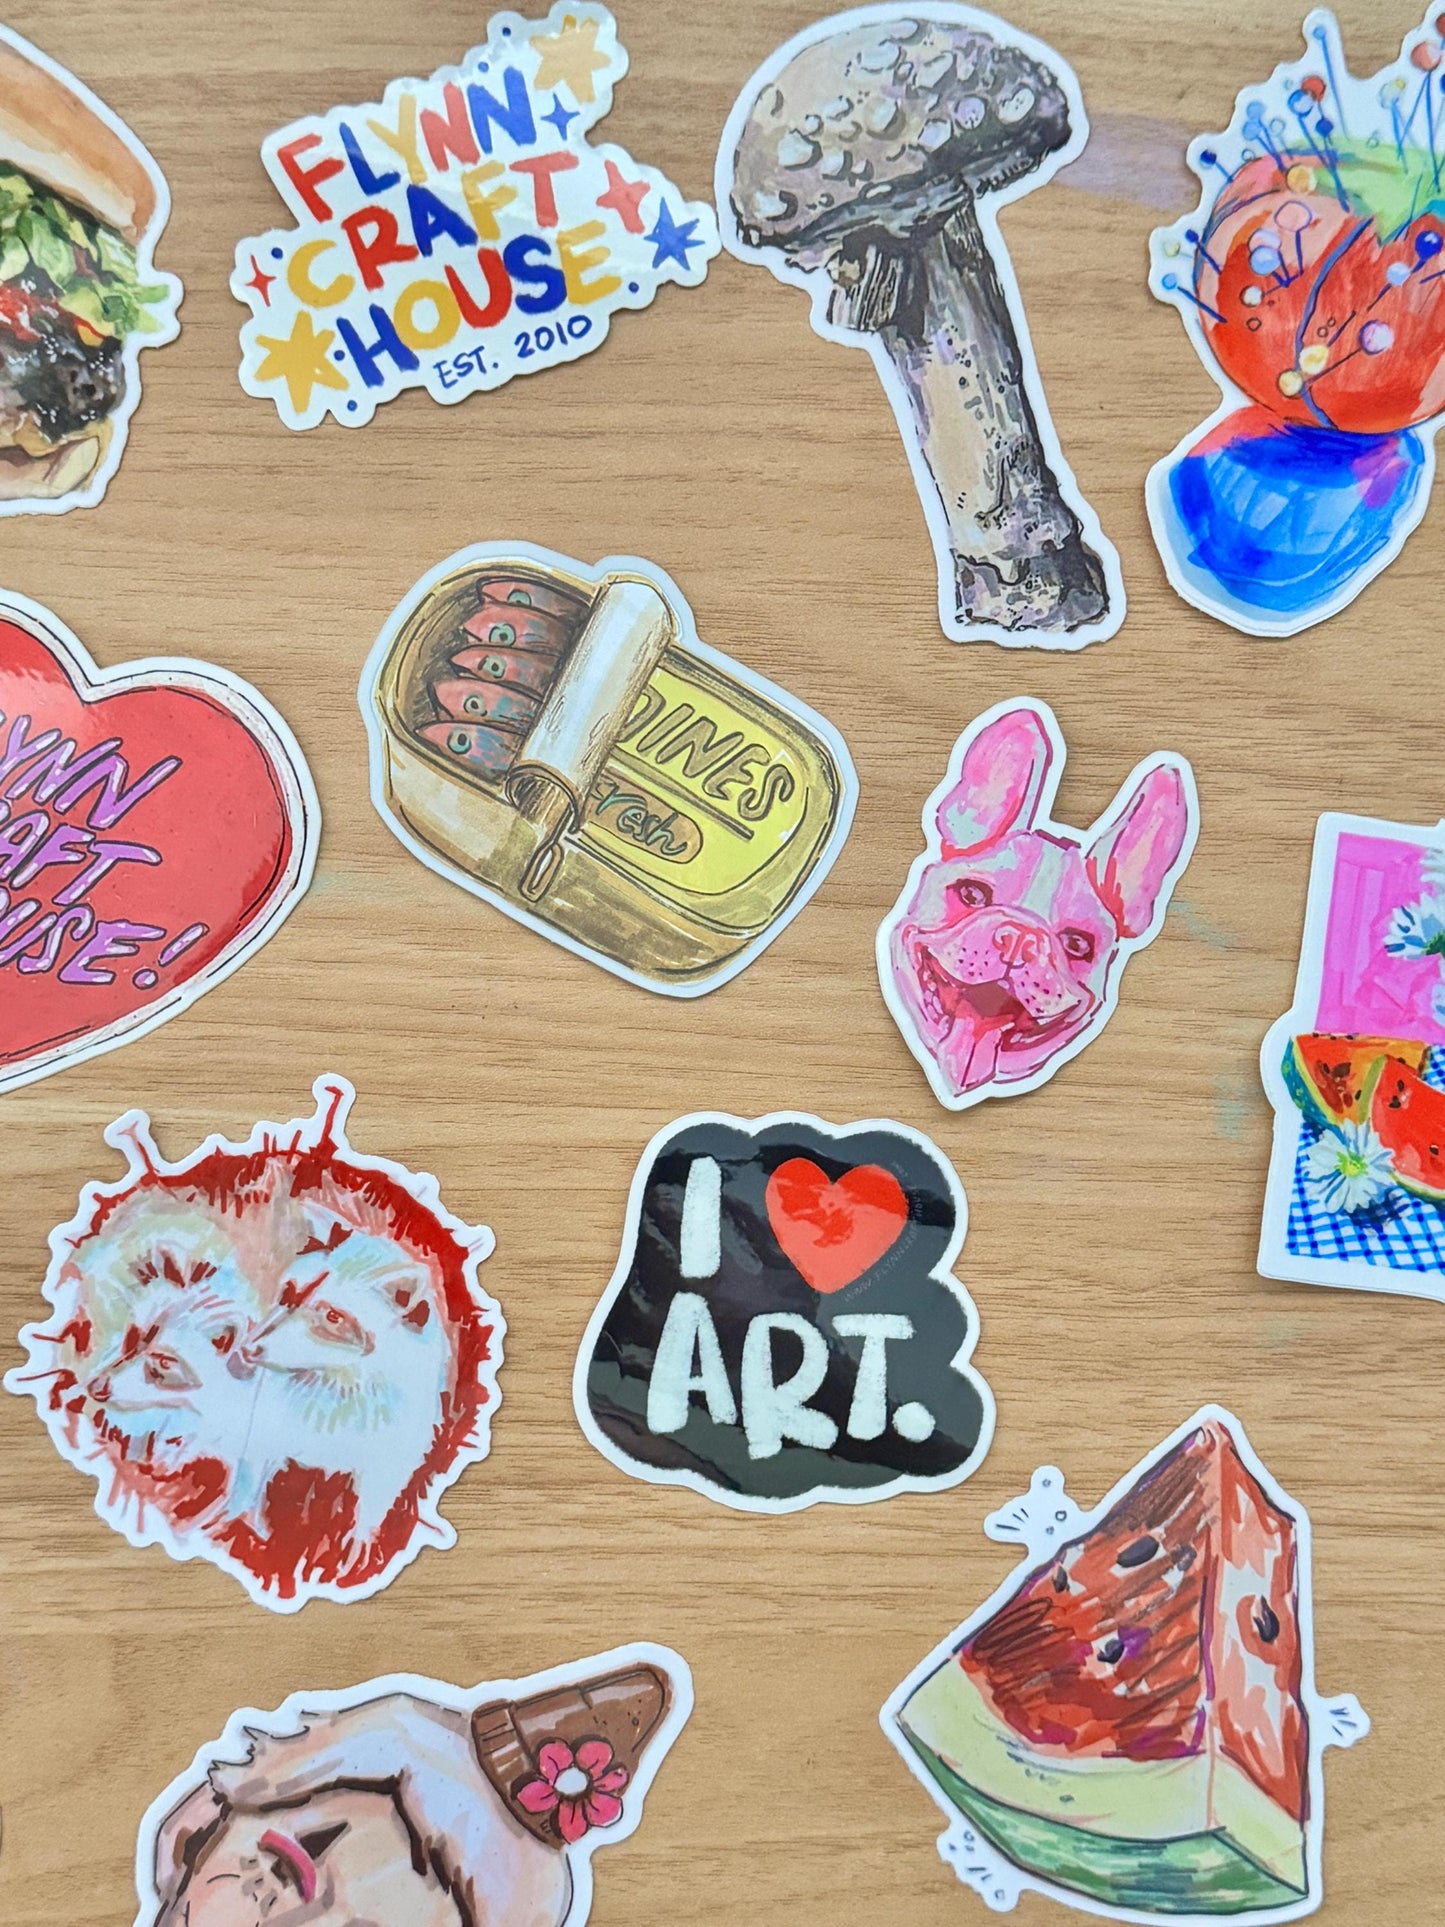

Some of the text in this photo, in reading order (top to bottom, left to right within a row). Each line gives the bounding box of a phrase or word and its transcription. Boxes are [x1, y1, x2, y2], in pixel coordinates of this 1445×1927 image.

[277, 66, 537, 223] FLYNN
[286, 150, 579, 309] CRAFT
[336, 220, 622, 388] HOUSE
[433, 314, 593, 389] EST. 2010
[0, 709, 183, 831] YNN
[0, 800, 163, 906] AFT
[0, 886, 210, 990] USE!
[679, 1155, 722, 1279] I
[646, 1291, 937, 1460] ART.
